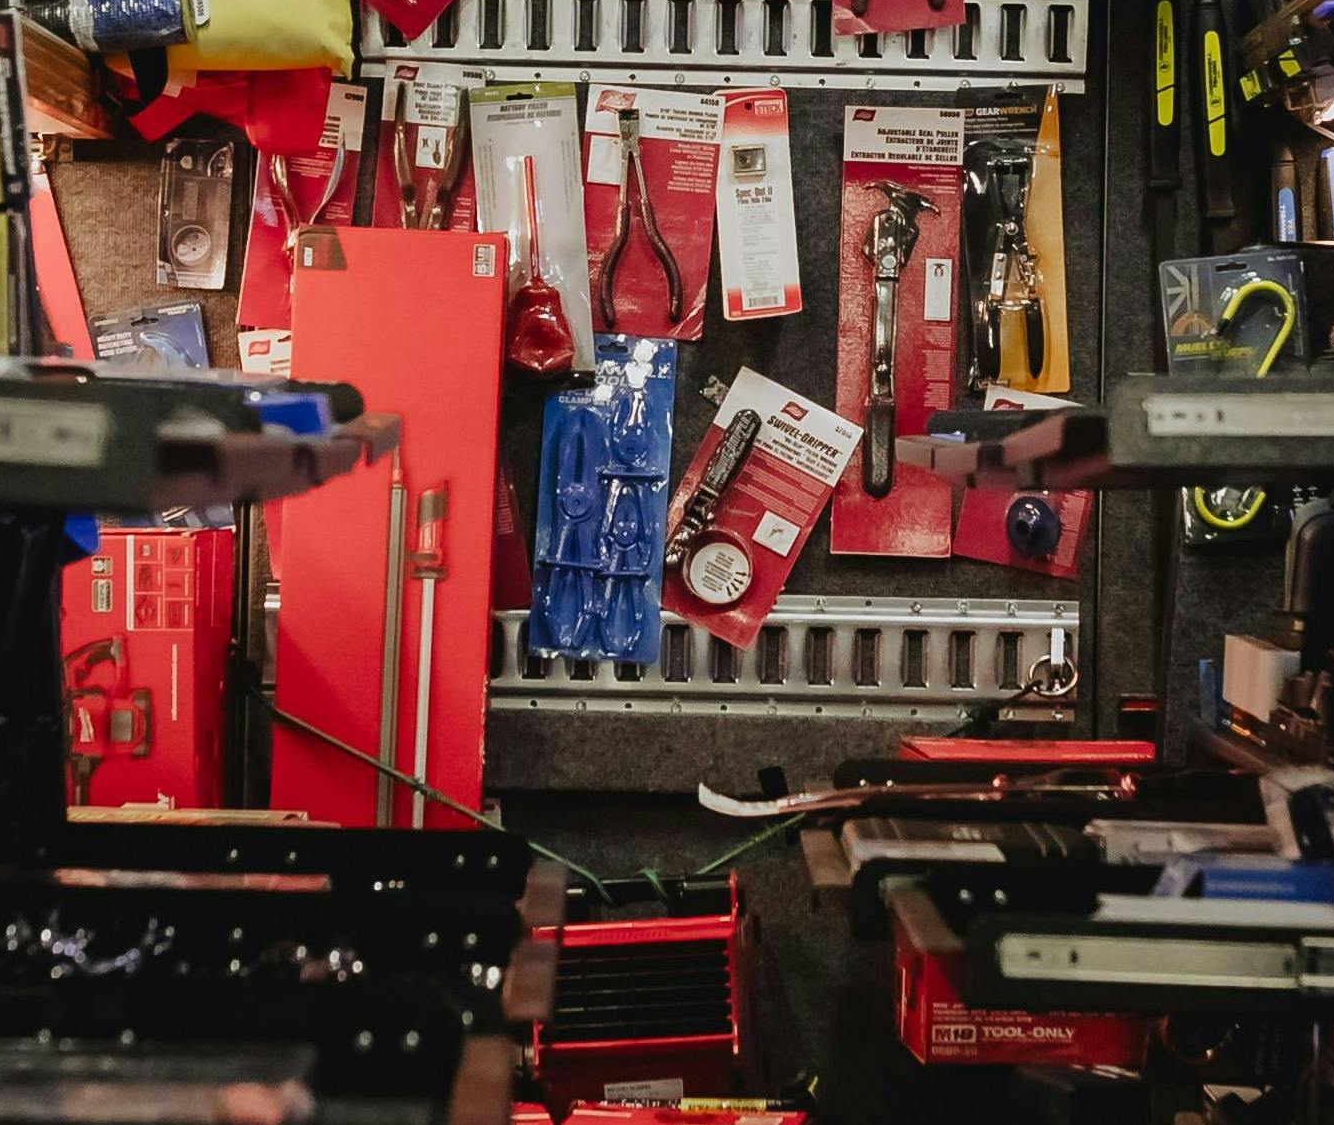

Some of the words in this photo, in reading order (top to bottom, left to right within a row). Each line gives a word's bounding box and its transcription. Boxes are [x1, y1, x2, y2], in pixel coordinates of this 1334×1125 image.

[756, 104, 782, 114] STECK
[975, 105, 1037, 116] GEARWRENCH
[558, 395, 592, 405] CLAMP
[934, 1026, 975, 1042] M18
[982, 1026, 1075, 1039] TOOL-ONLY
